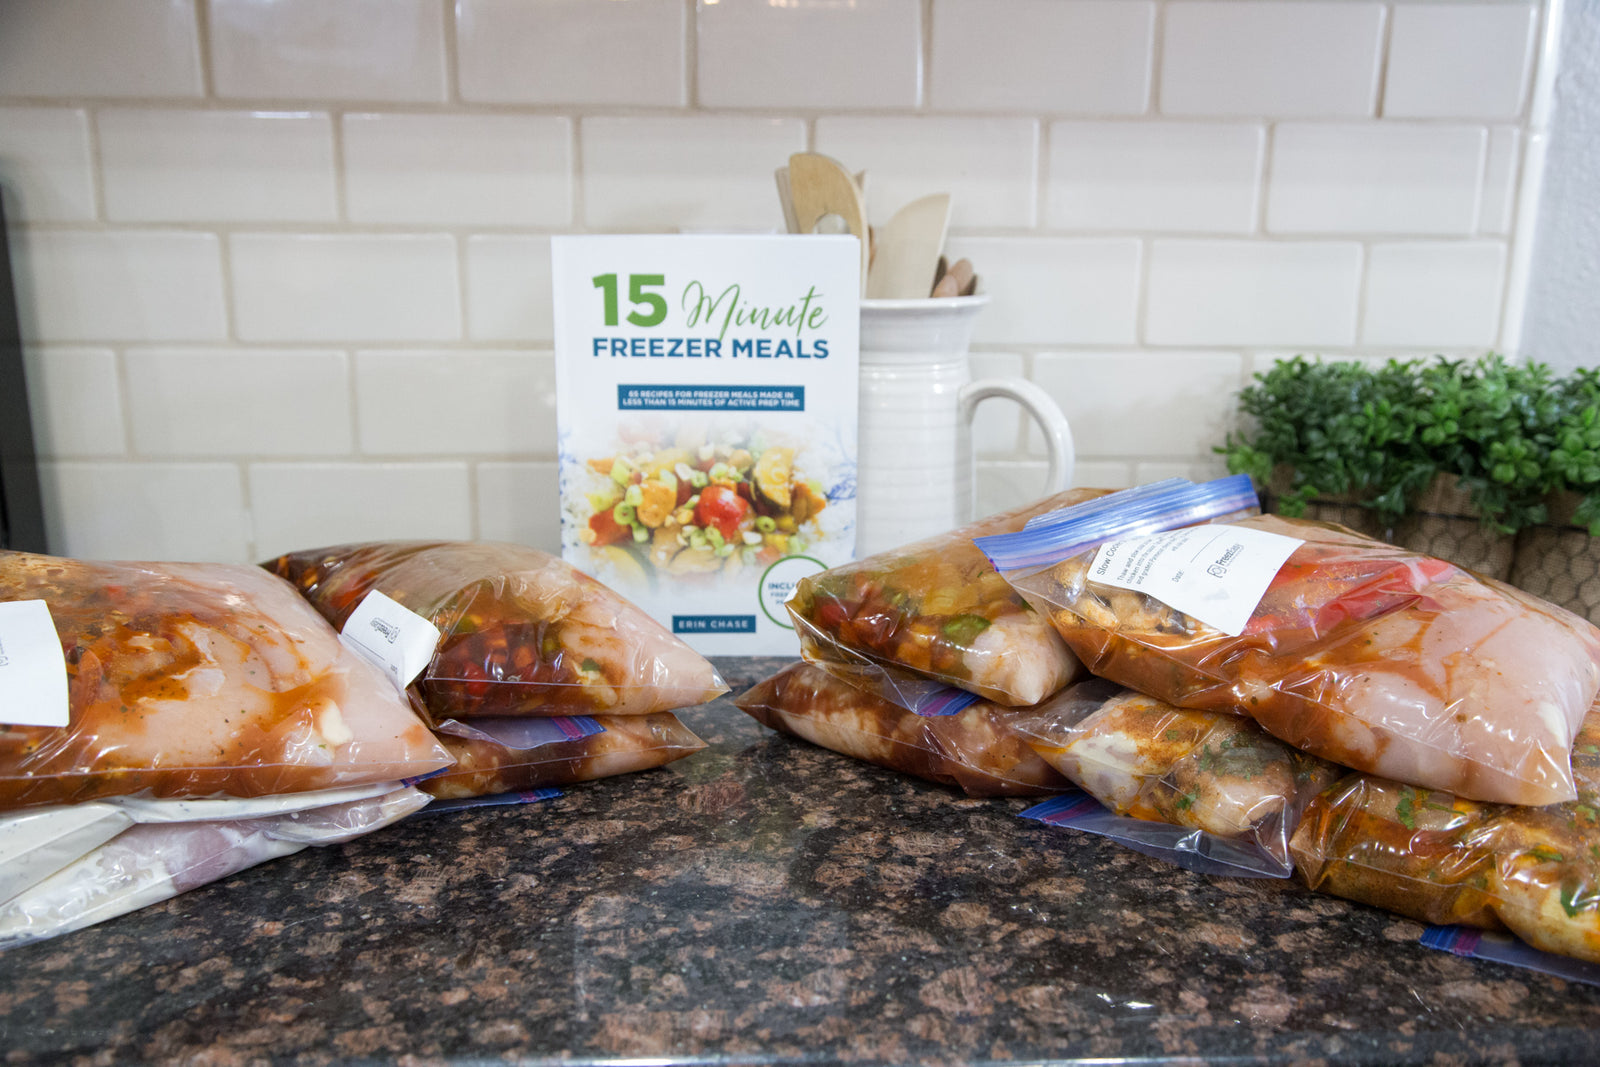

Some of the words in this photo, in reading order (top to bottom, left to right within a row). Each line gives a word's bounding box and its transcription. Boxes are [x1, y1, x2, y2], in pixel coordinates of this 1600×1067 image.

[592, 273, 668, 327] 15
[682, 280, 829, 341] Minute
[592, 338, 722, 358] FREEZER
[732, 338, 829, 359] MEALS
[675, 390, 692, 398] FOR
[784, 391, 794, 399] IN
[622, 398, 642, 406] LESS
[644, 398, 667, 406] THAN
[668, 398, 676, 406] 15
[677, 398, 713, 406] MINUTES
[727, 399, 757, 407] ACTIVE
[758, 399, 779, 407] PREP
[780, 399, 800, 407] TIME
[1096, 558, 1111, 575] Slow
[678, 620, 706, 629] ERIN
[710, 620, 749, 629] CHASE
